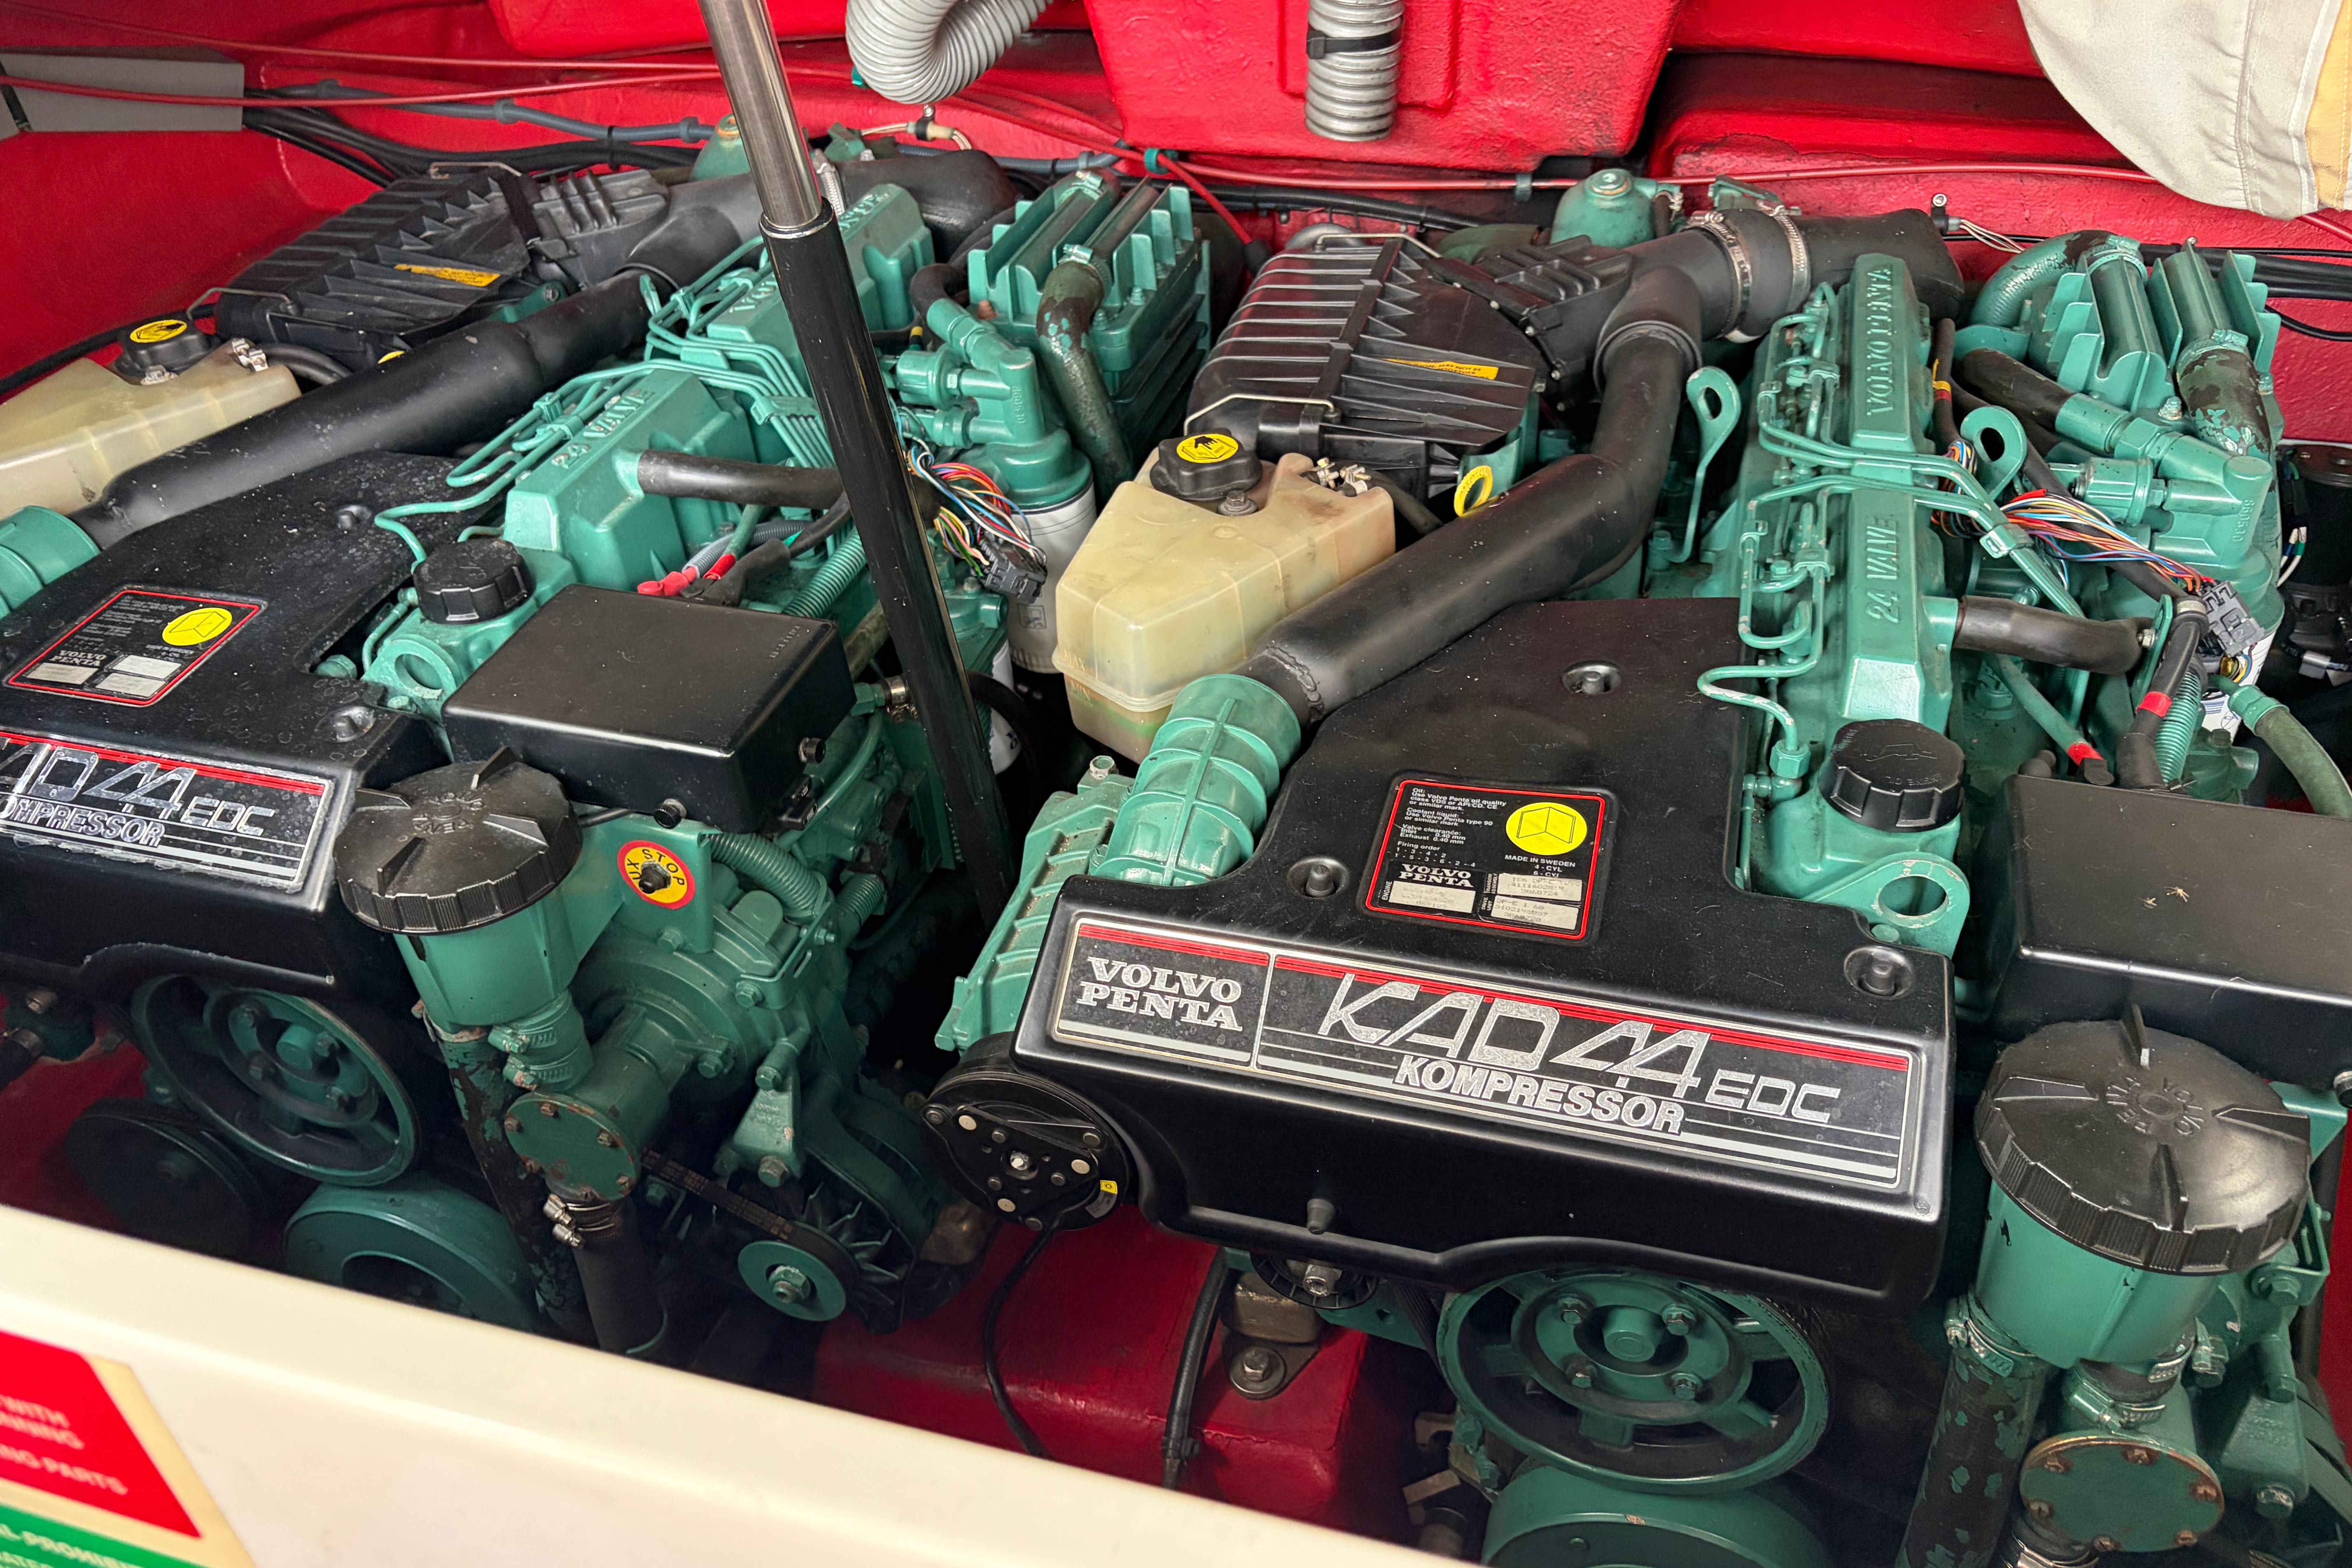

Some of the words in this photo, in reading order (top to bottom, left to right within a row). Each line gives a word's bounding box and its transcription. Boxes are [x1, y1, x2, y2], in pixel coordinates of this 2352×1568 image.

[1867, 268, 1893, 336] PENTA
[1867, 341, 1894, 415] VOLVO
[551, 443, 591, 469] 24
[583, 389, 656, 437] VALVE
[1867, 516, 1897, 580] VALVE
[1865, 589, 1899, 623] 24
[49, 656, 101, 666] PENTA
[59, 650, 107, 660] VOLVO
[1064, 649, 1085, 672] MAX
[1071, 680, 1091, 702] MIN
[0, 737, 197, 819] AD44
[180, 796, 275, 836] EDC
[0, 795, 166, 848] OMPRESSOR
[1407, 807, 1435, 815] Coolant
[1398, 841, 1419, 849] Firing
[1400, 832, 1429, 840] Exhaust
[642, 848, 685, 886] STOP
[1399, 871, 1474, 887] PENTA
[1402, 863, 1471, 879] VOLVO
[1540, 859, 1576, 868] SWEDEN
[1381, 880, 1393, 901] ENGINE
[1087, 957, 1242, 1003] VOLVO
[1076, 981, 1243, 1032] PENTA
[1395, 1054, 1686, 1136] KOMPRESSOR
[1704, 1069, 1841, 1123] EDC
[2106, 1077, 2149, 1134] PENTA
[2163, 1076, 2204, 1135] VOLVO
[42, 1456, 128, 1496] PARTS
